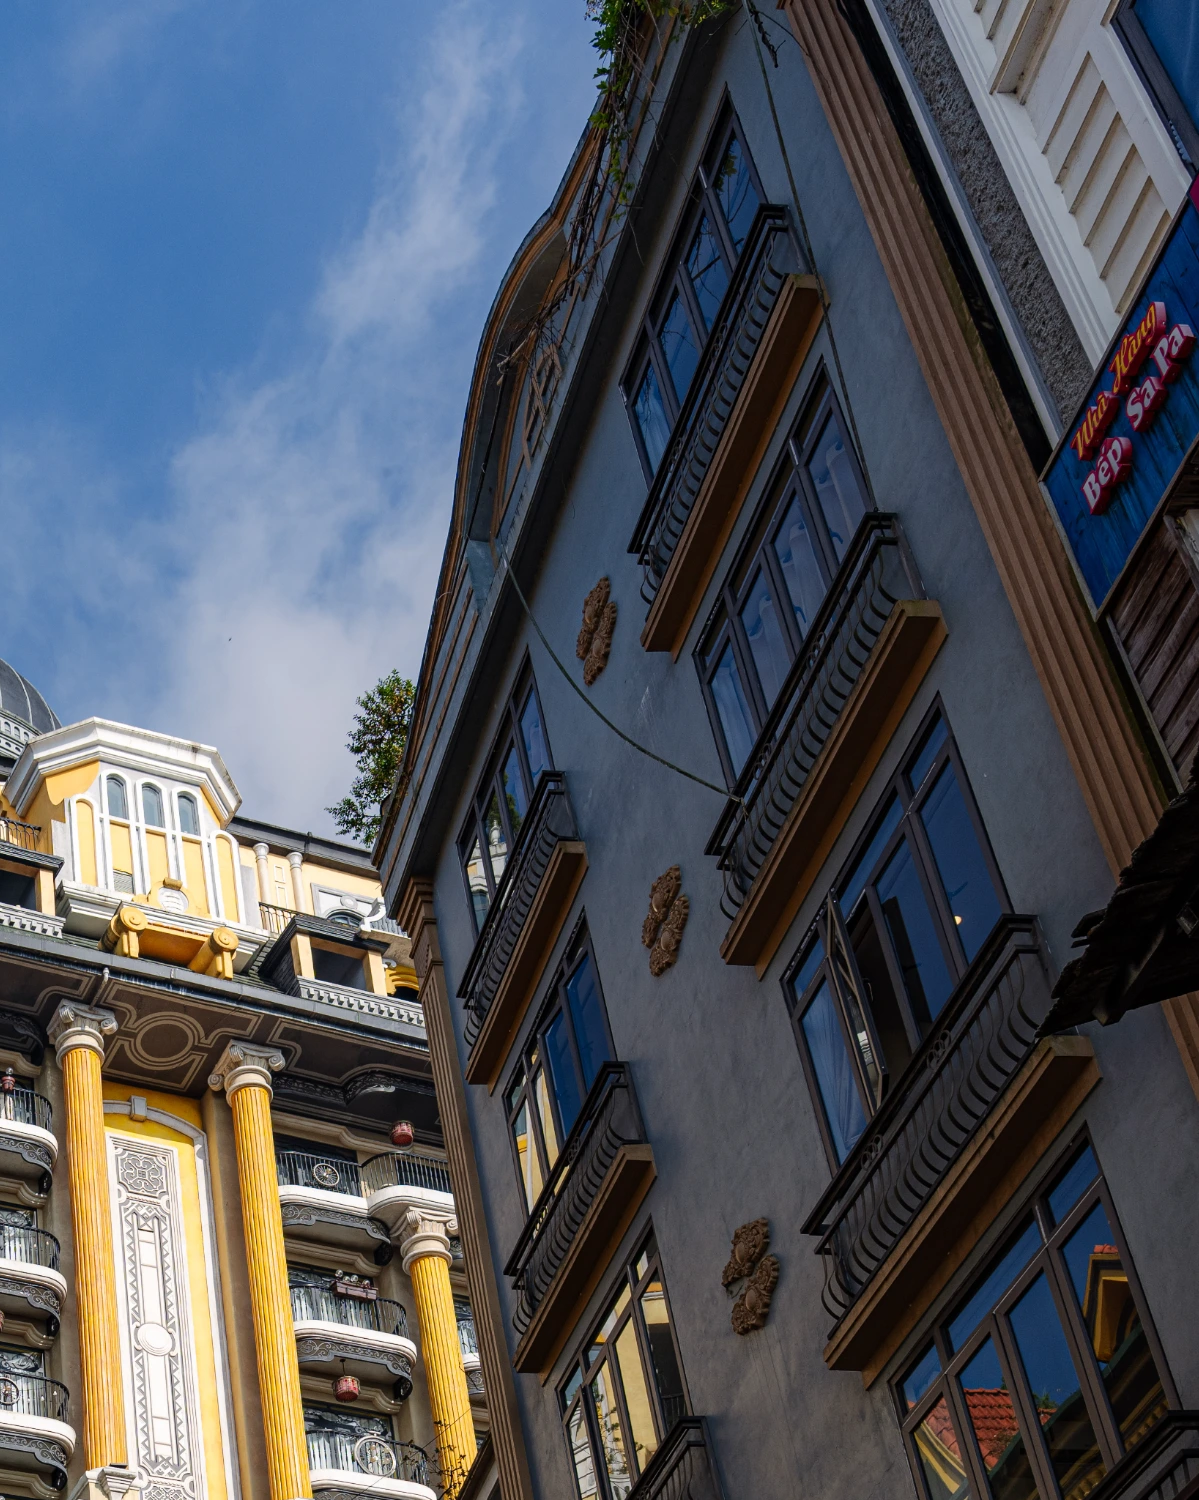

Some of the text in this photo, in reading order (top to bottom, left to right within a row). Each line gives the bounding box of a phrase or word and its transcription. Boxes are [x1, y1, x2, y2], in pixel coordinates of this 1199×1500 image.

[1082, 328, 1186, 515] Bếp Sa Pa
